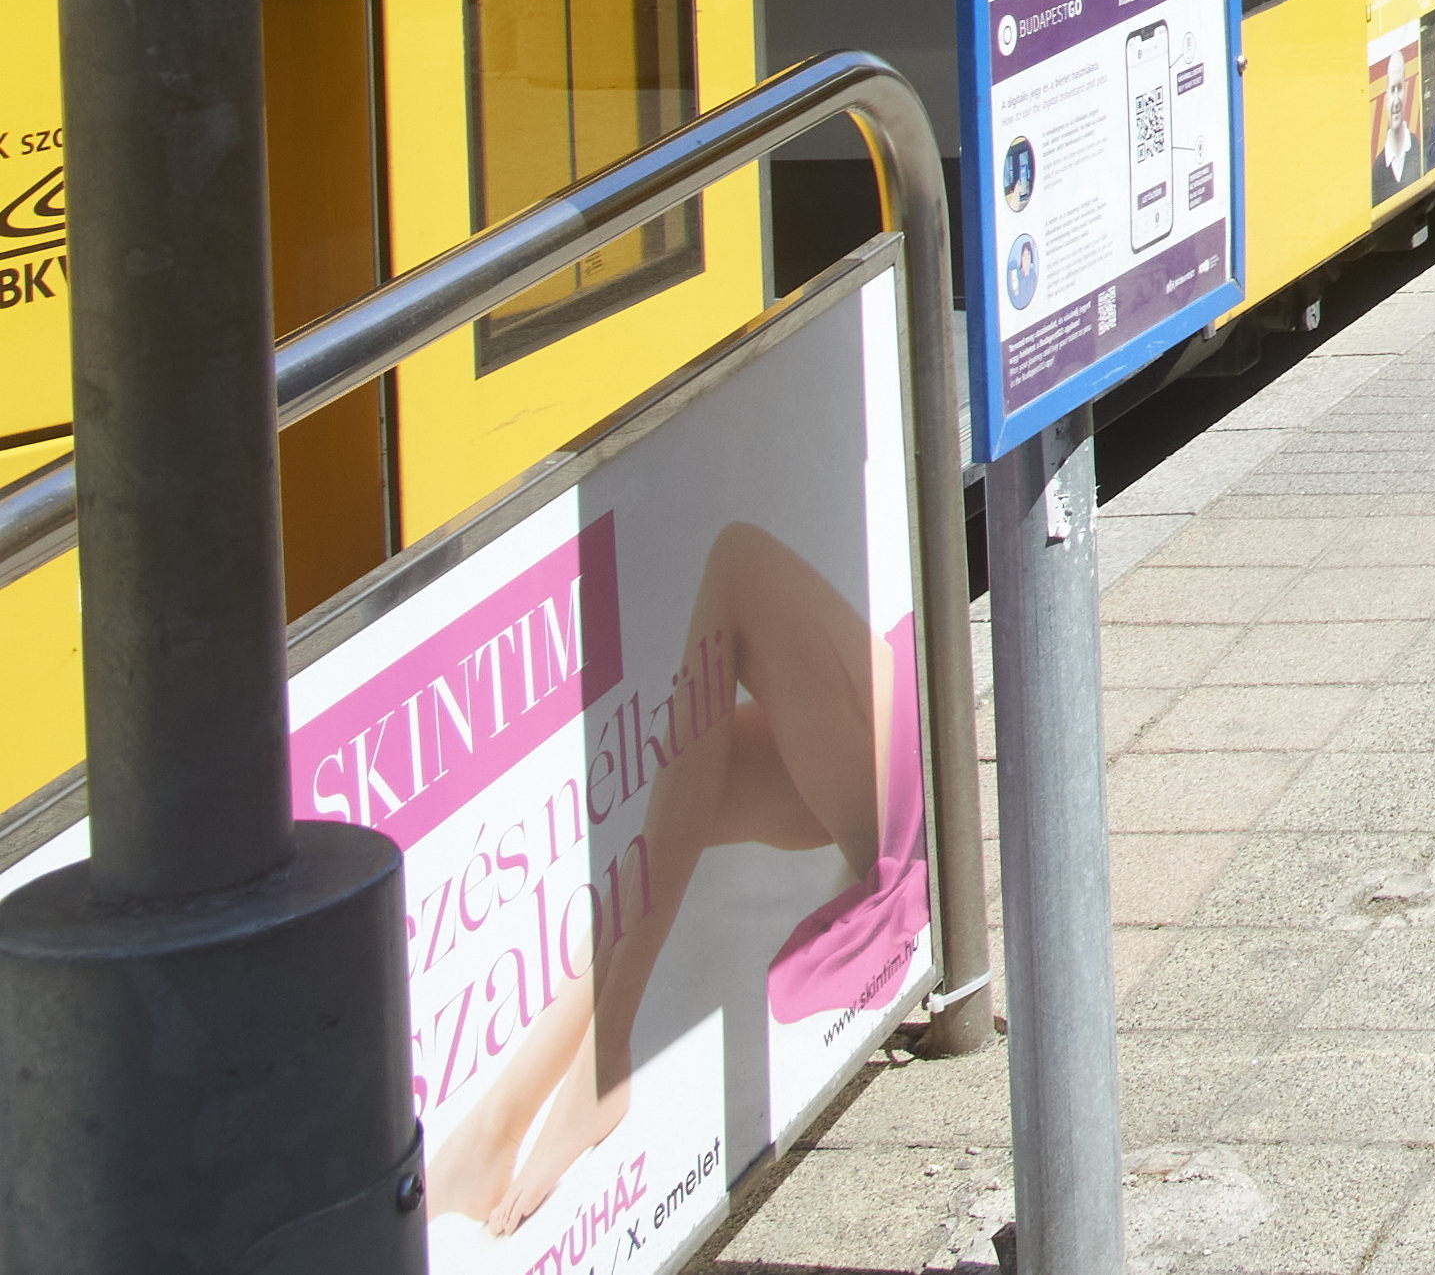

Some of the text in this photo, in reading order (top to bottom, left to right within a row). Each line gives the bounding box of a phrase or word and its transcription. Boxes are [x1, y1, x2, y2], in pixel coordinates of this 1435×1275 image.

[313, 575, 589, 829] SKINTIM
[544, 629, 731, 869] nélküli
[823, 932, 919, 1047] www.skintim.hu
[653, 1136, 721, 1229] emelet
